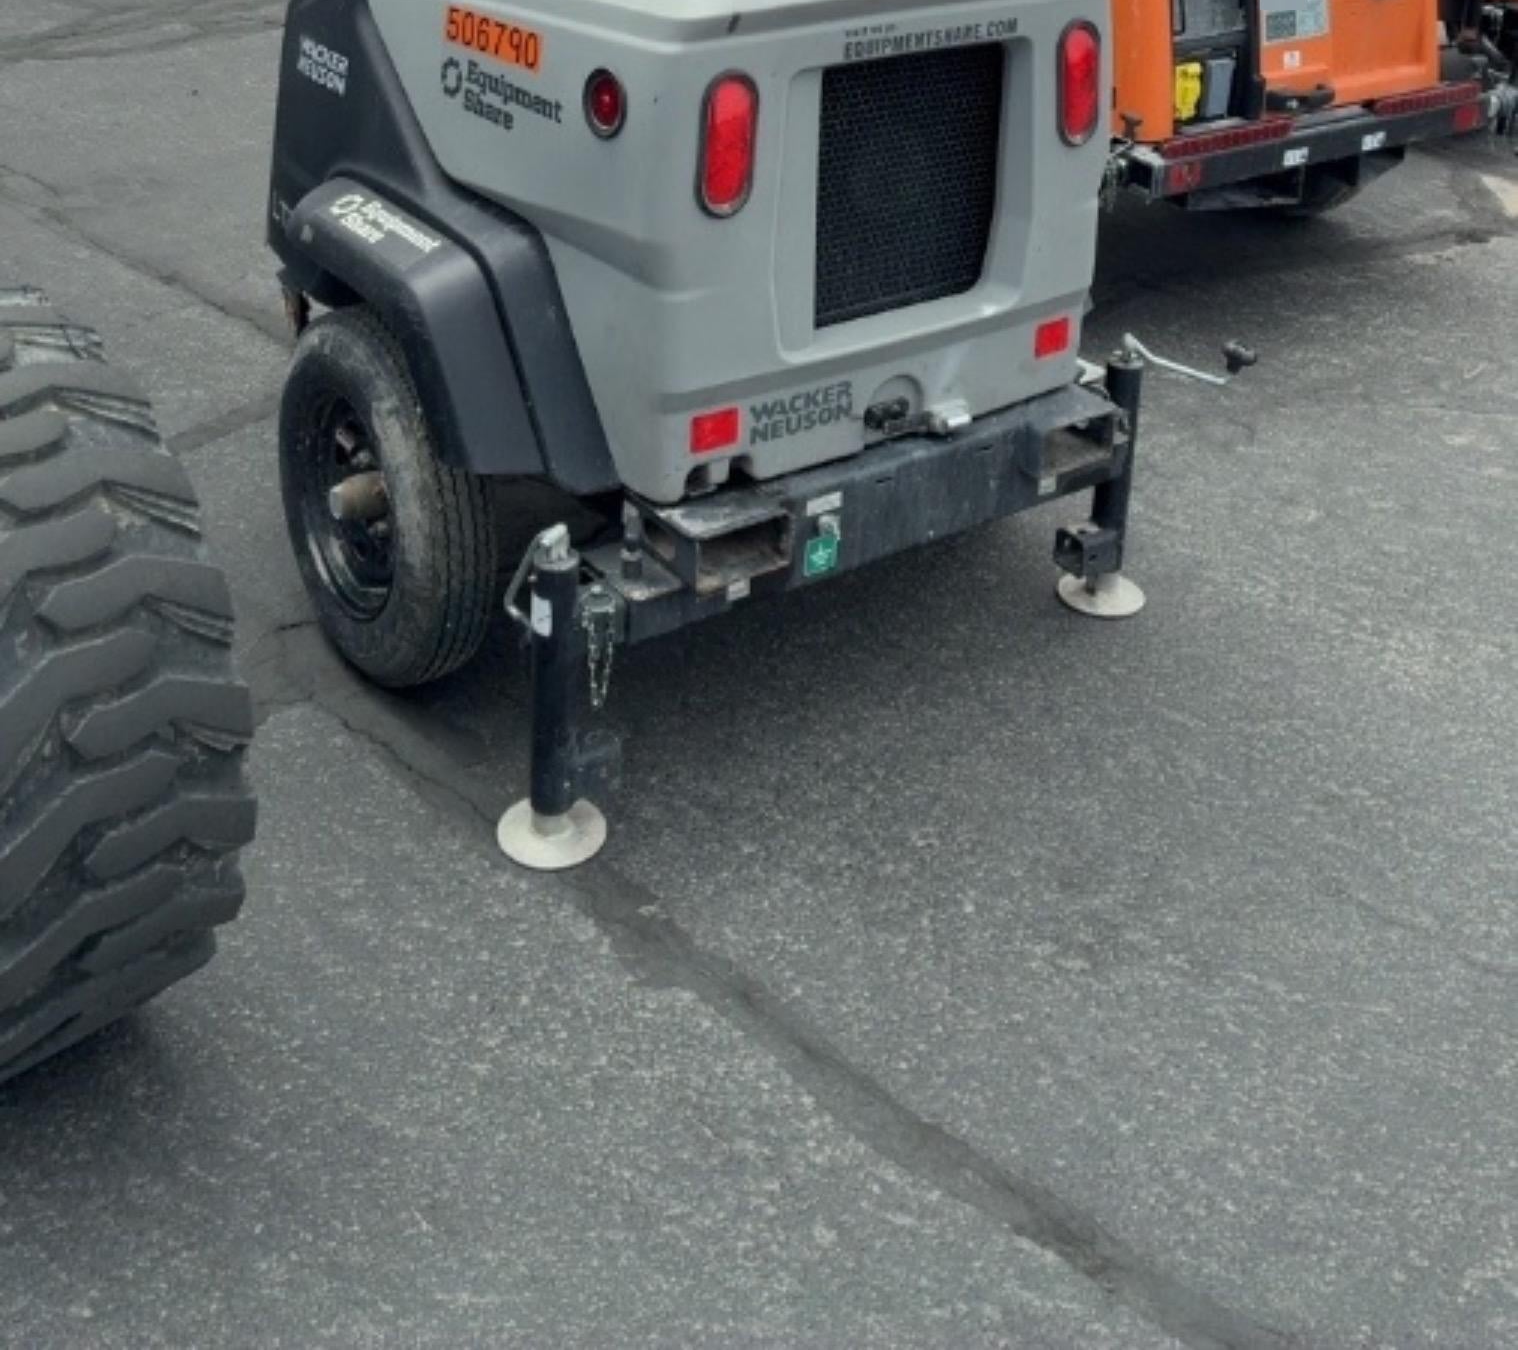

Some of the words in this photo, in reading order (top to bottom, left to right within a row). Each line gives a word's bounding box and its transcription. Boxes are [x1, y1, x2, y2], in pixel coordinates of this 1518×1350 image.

[301, 36, 350, 77] WACKER
[446, 6, 538, 69] 506790
[296, 55, 347, 96] NEUSON
[465, 58, 563, 124] Equipment
[463, 87, 515, 131] Share
[340, 212, 385, 244] Share
[361, 200, 442, 253] Equipment
[749, 380, 853, 422] WACKER
[749, 401, 853, 445] NEUSON
